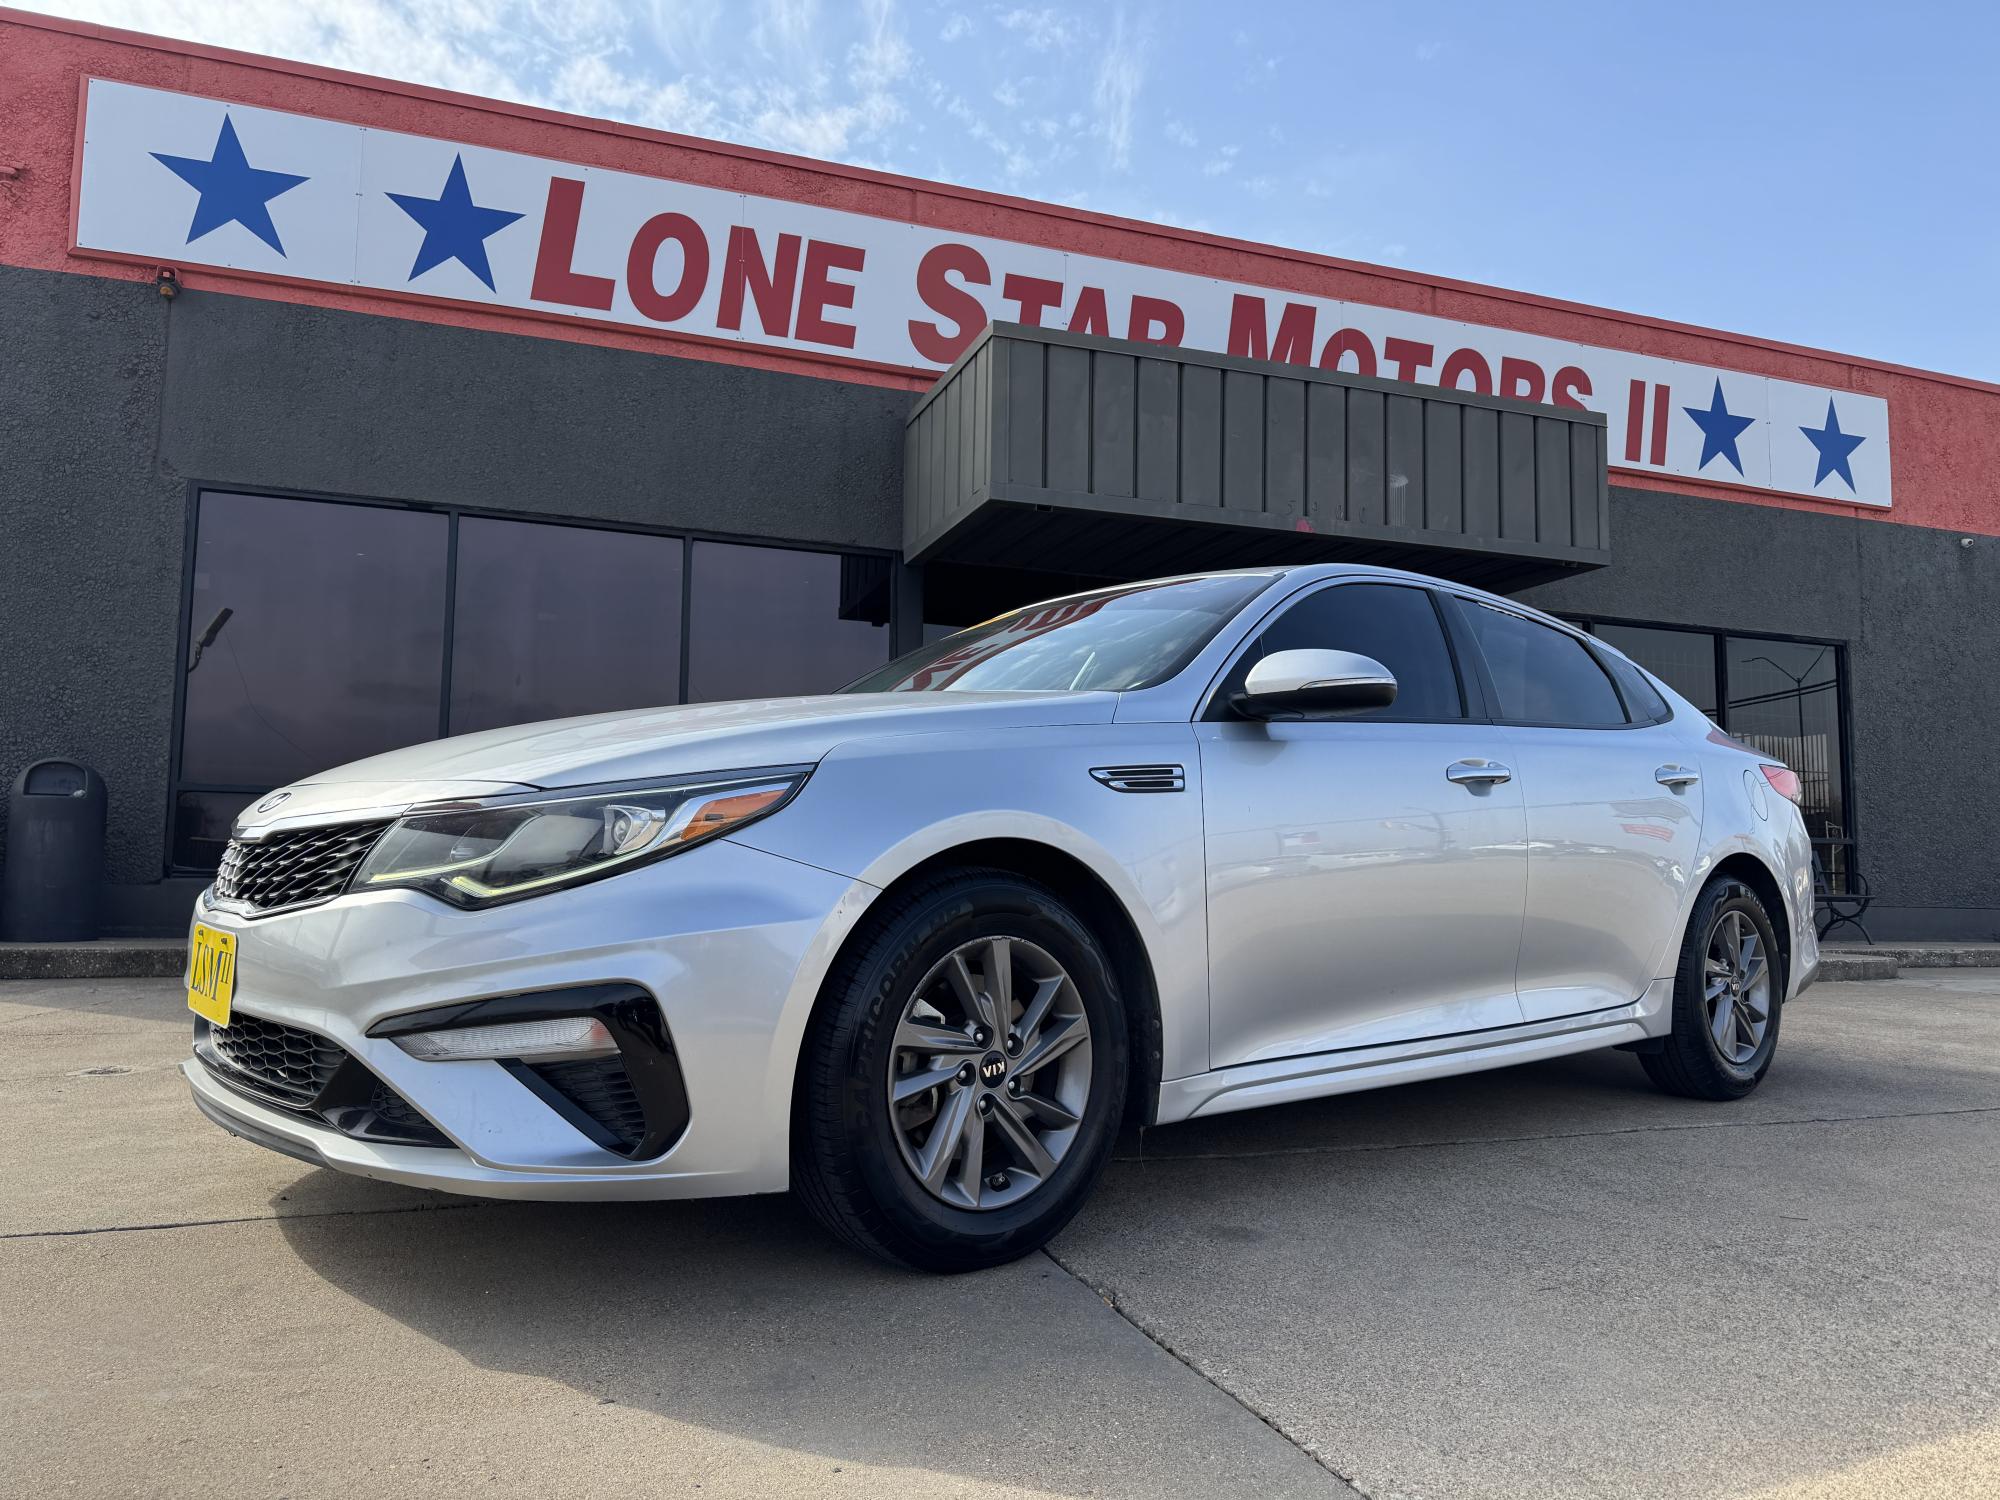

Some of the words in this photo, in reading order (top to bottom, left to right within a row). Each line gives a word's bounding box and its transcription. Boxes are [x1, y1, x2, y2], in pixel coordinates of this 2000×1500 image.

[530, 176, 866, 350] LONE
[1625, 379, 1670, 467] II
[191, 941, 223, 1001] LSM
[982, 1061, 1005, 1079] KIA
